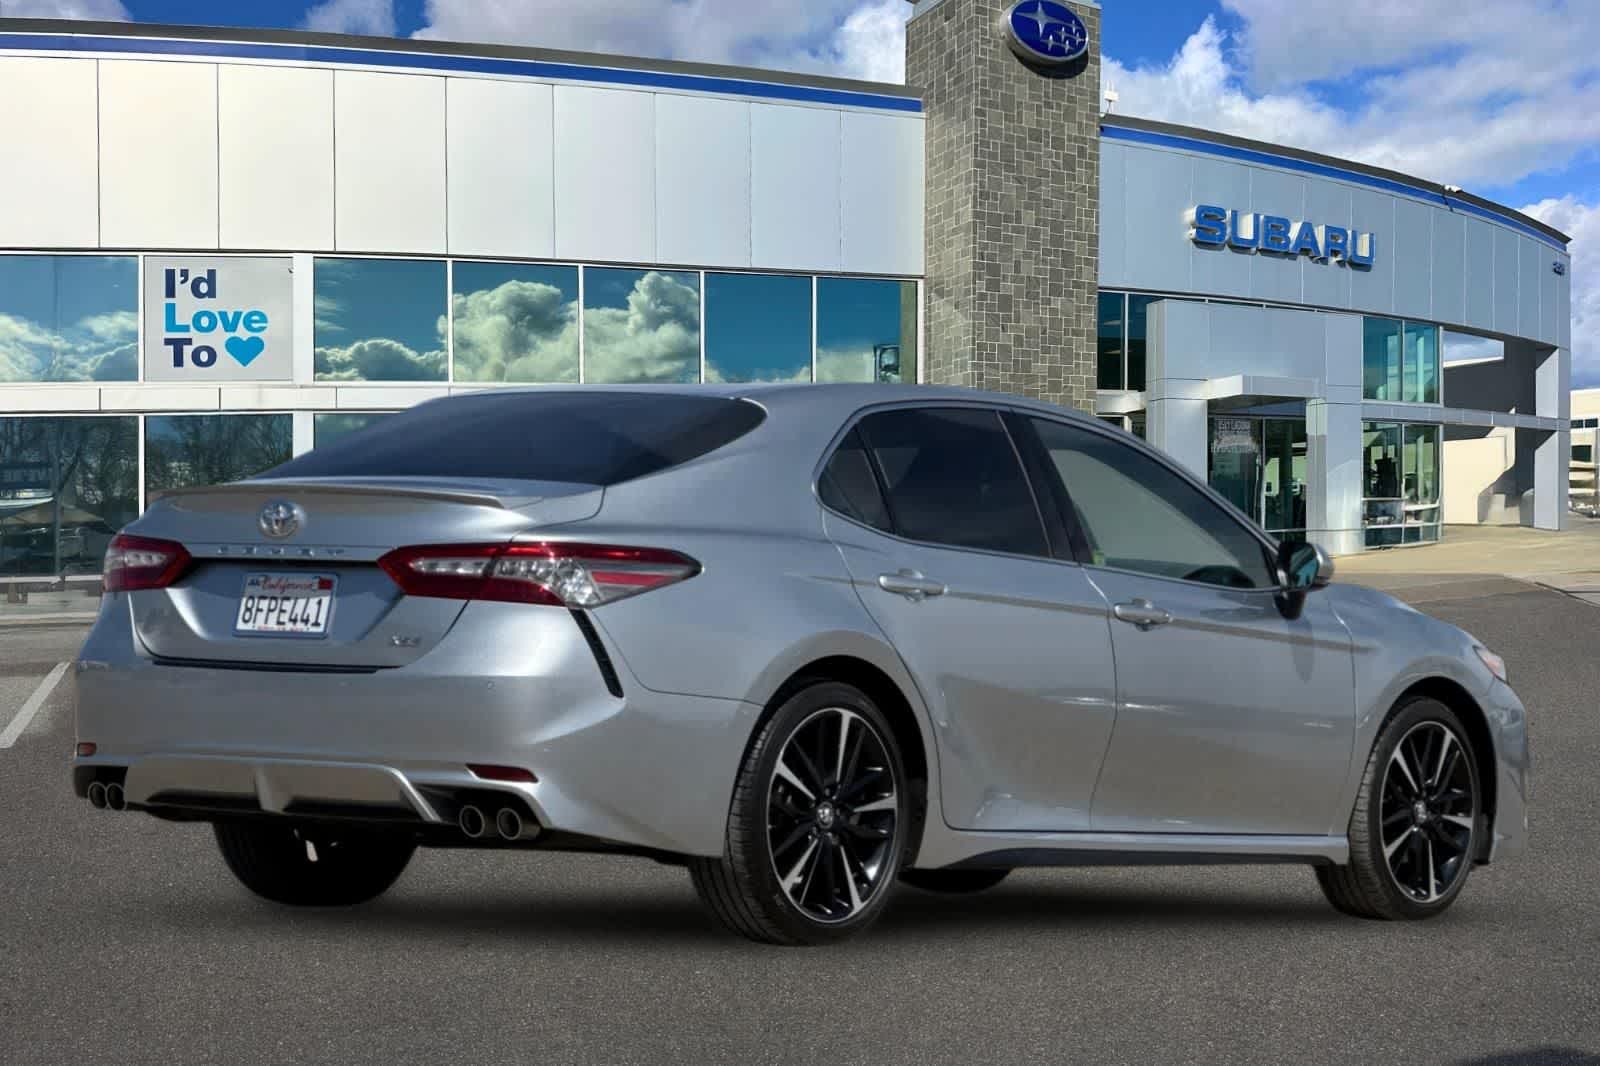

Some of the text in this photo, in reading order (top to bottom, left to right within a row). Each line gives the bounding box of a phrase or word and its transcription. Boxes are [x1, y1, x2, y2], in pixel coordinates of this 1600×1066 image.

[1193, 204, 1376, 266] SUBARU
[165, 302, 269, 333] Love
[163, 337, 218, 369] To
[241, 595, 323, 627] 8FPE441
